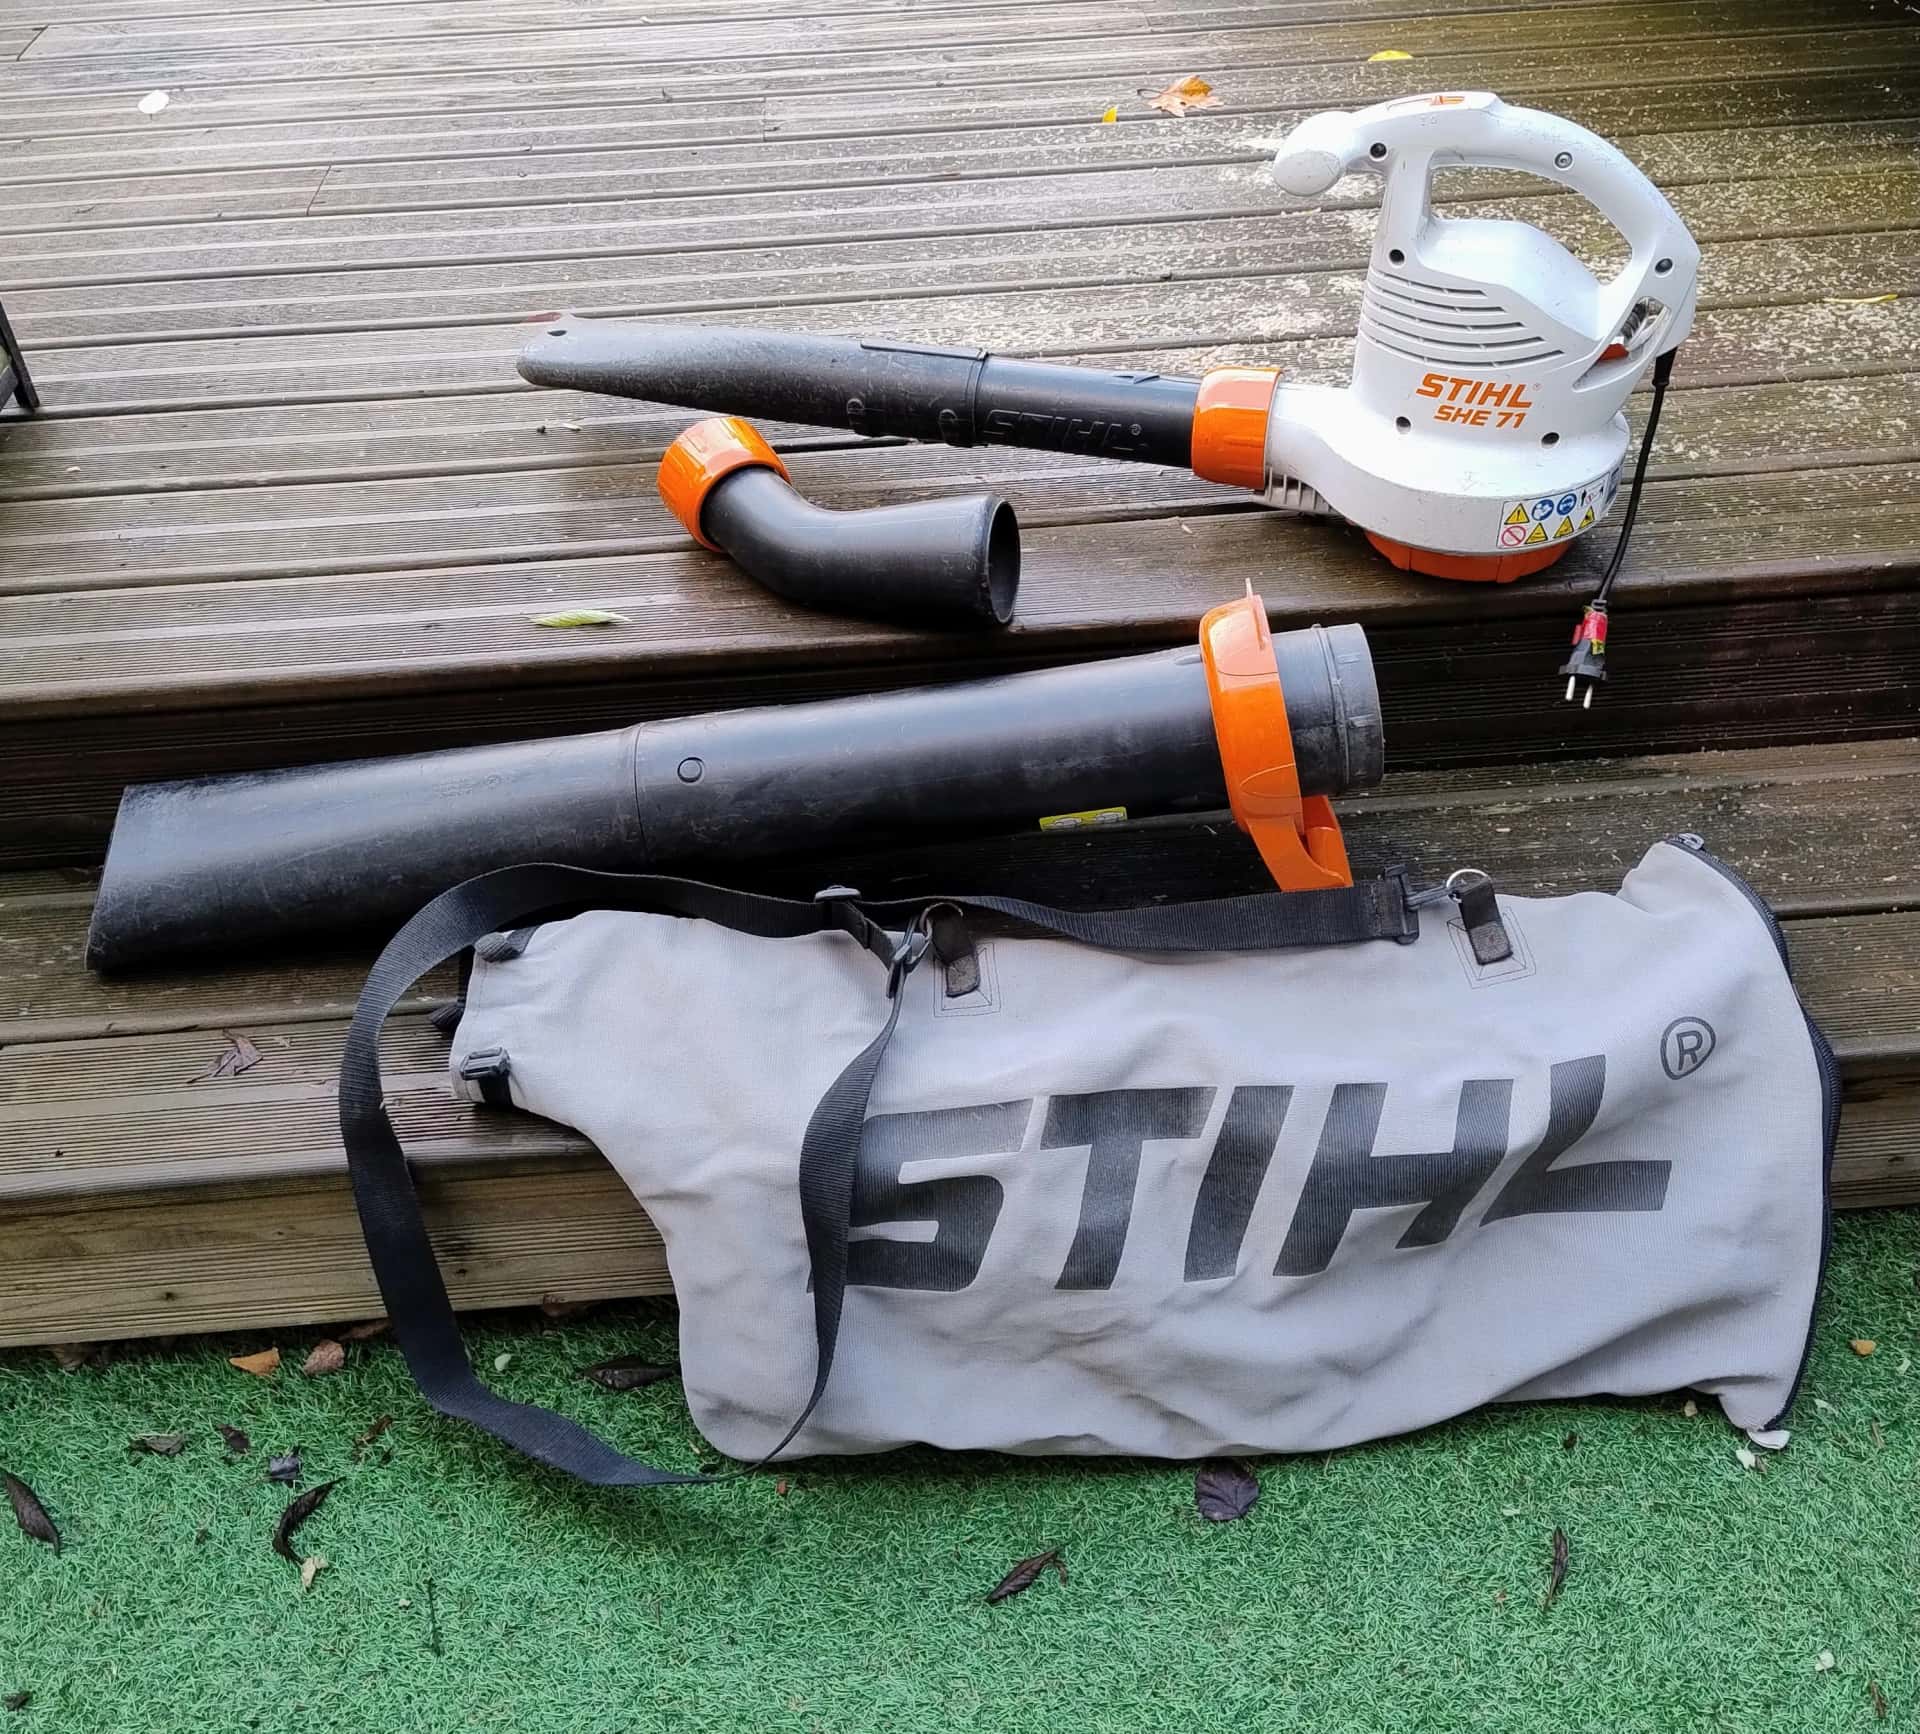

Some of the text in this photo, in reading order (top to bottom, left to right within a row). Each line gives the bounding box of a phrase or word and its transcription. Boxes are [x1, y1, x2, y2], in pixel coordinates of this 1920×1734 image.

[1416, 373, 1532, 408] STIHL
[1435, 405, 1526, 428] SHE 71
[807, 1055, 1672, 1292] STIHL
